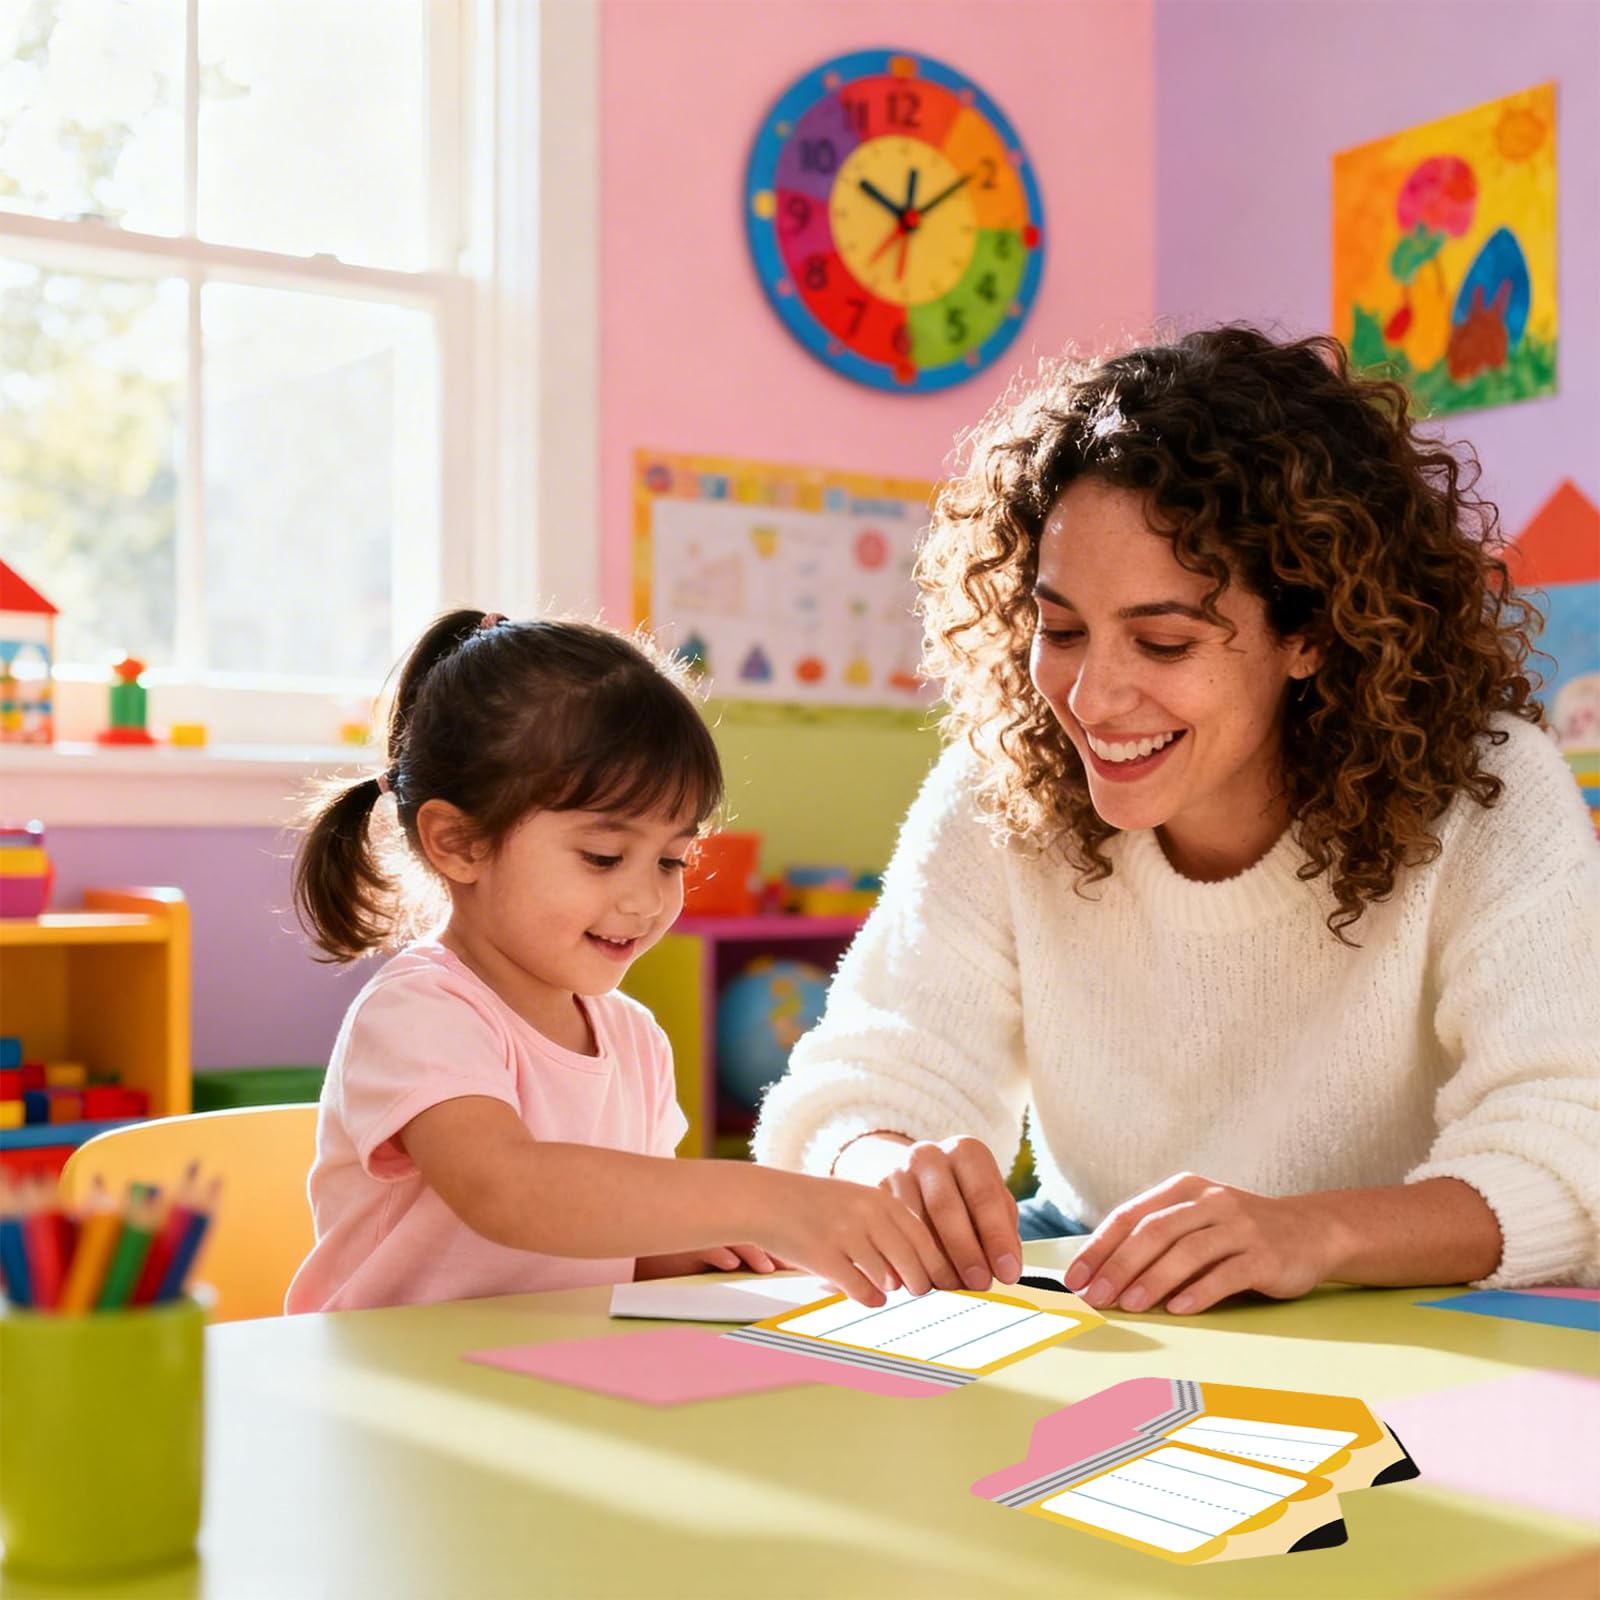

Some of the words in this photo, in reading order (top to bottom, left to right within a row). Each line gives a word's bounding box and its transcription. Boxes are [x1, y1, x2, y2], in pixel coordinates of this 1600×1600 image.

[841, 97, 868, 132] 11
[886, 91, 922, 128] 12
[800, 137, 837, 175] 10
[980, 157, 998, 191] 2
[786, 196, 811, 237] 9
[804, 256, 828, 291] 8
[976, 272, 998, 303] 4
[846, 298, 868, 337] 7
[946, 308, 968, 344] 5
